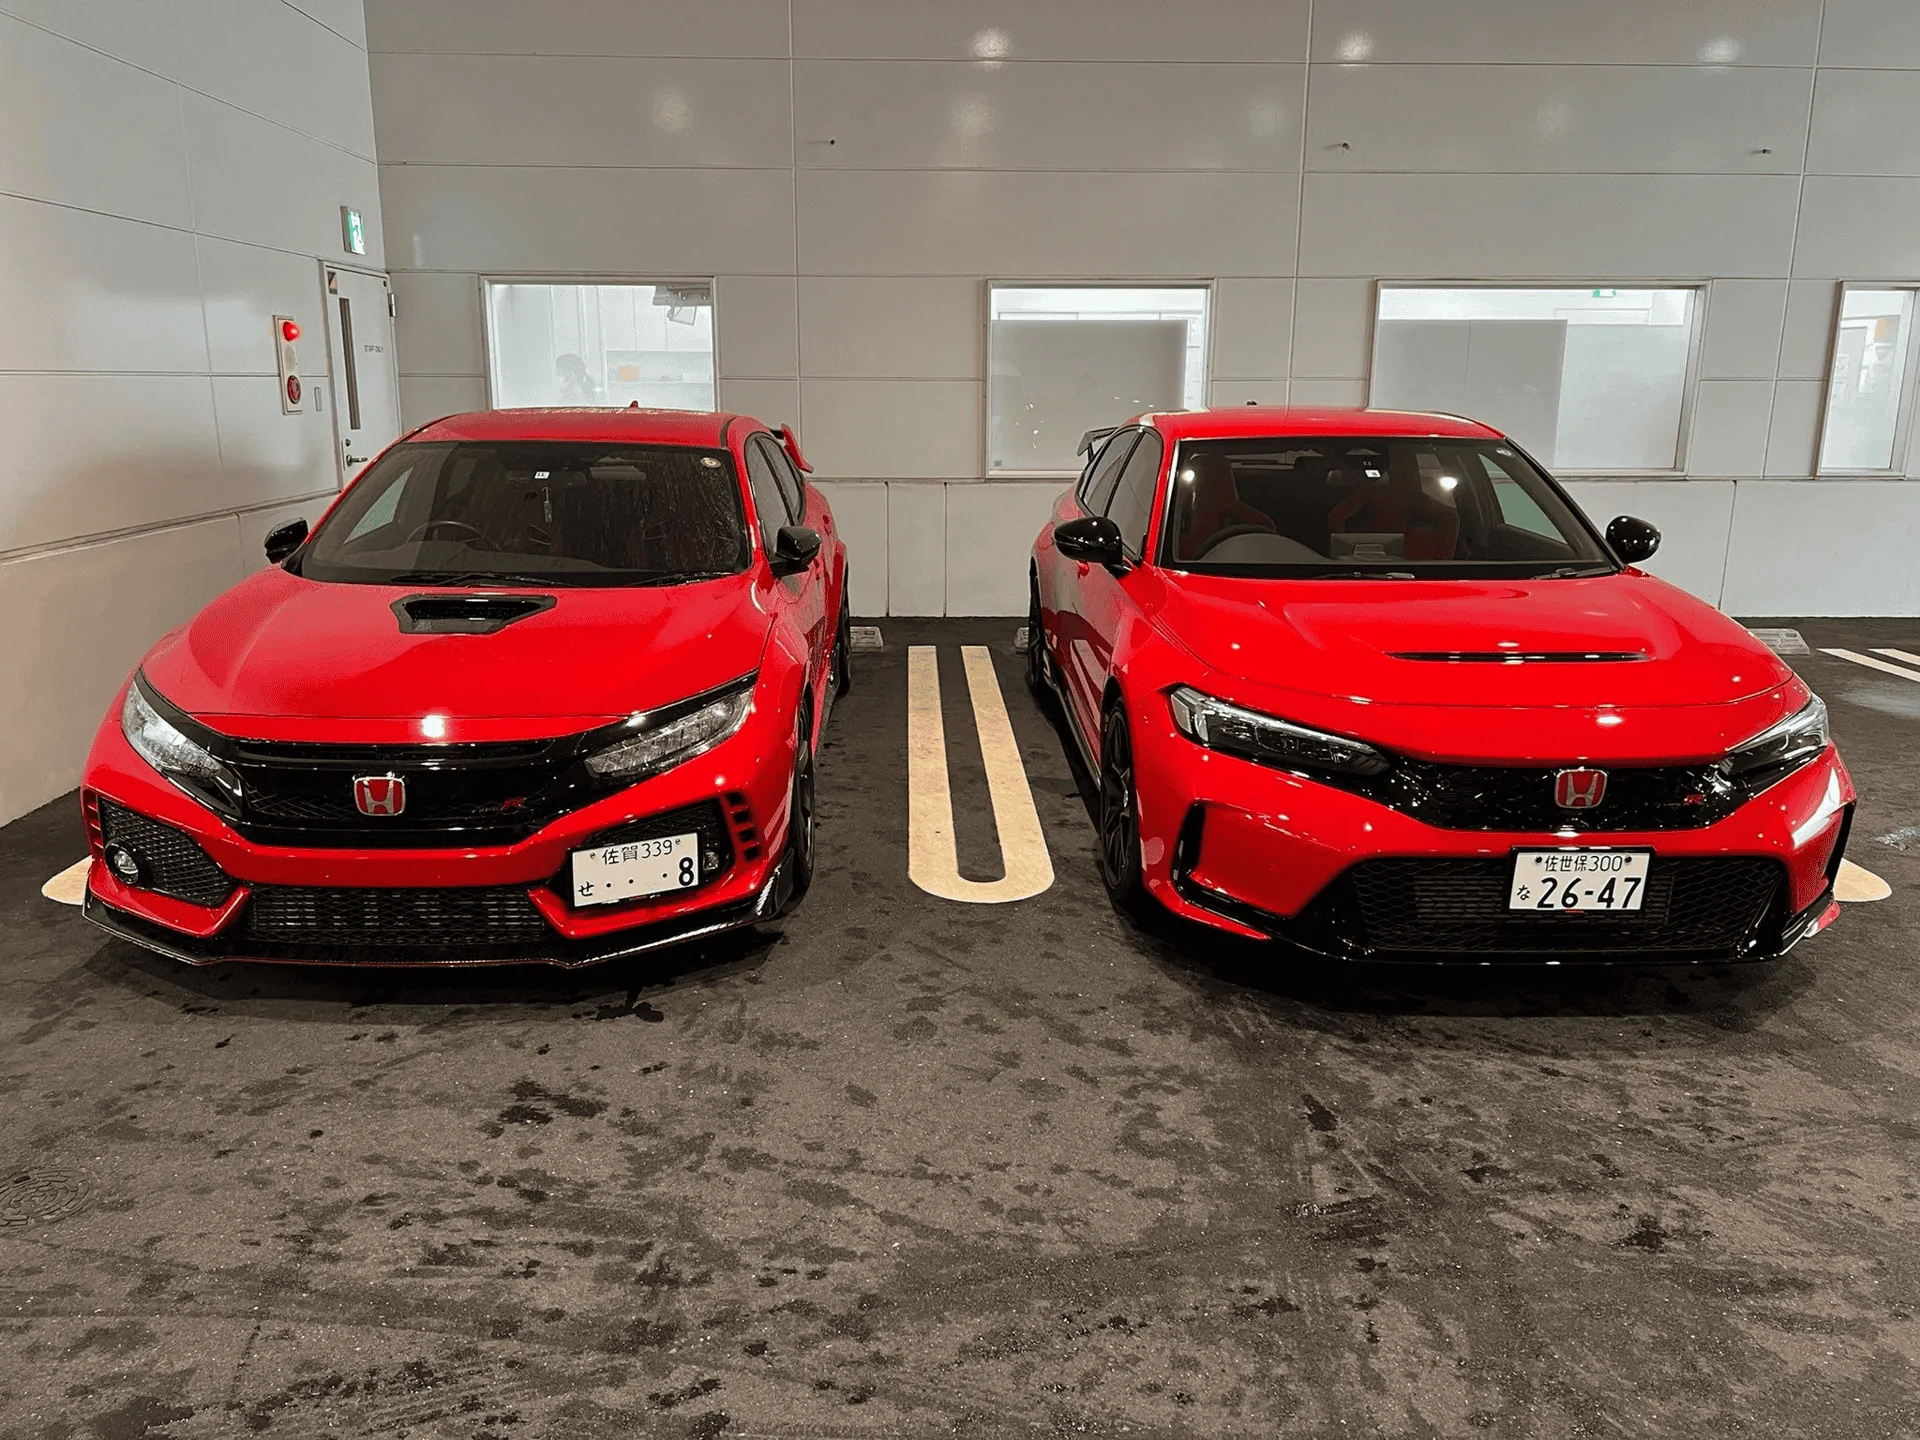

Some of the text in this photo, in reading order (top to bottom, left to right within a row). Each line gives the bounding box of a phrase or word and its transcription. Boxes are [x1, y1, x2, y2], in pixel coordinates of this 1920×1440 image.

[602, 839, 673, 865] 佐賀339
[1544, 855, 1623, 872] 佐世保300
[1537, 877, 1642, 908] 26-47
